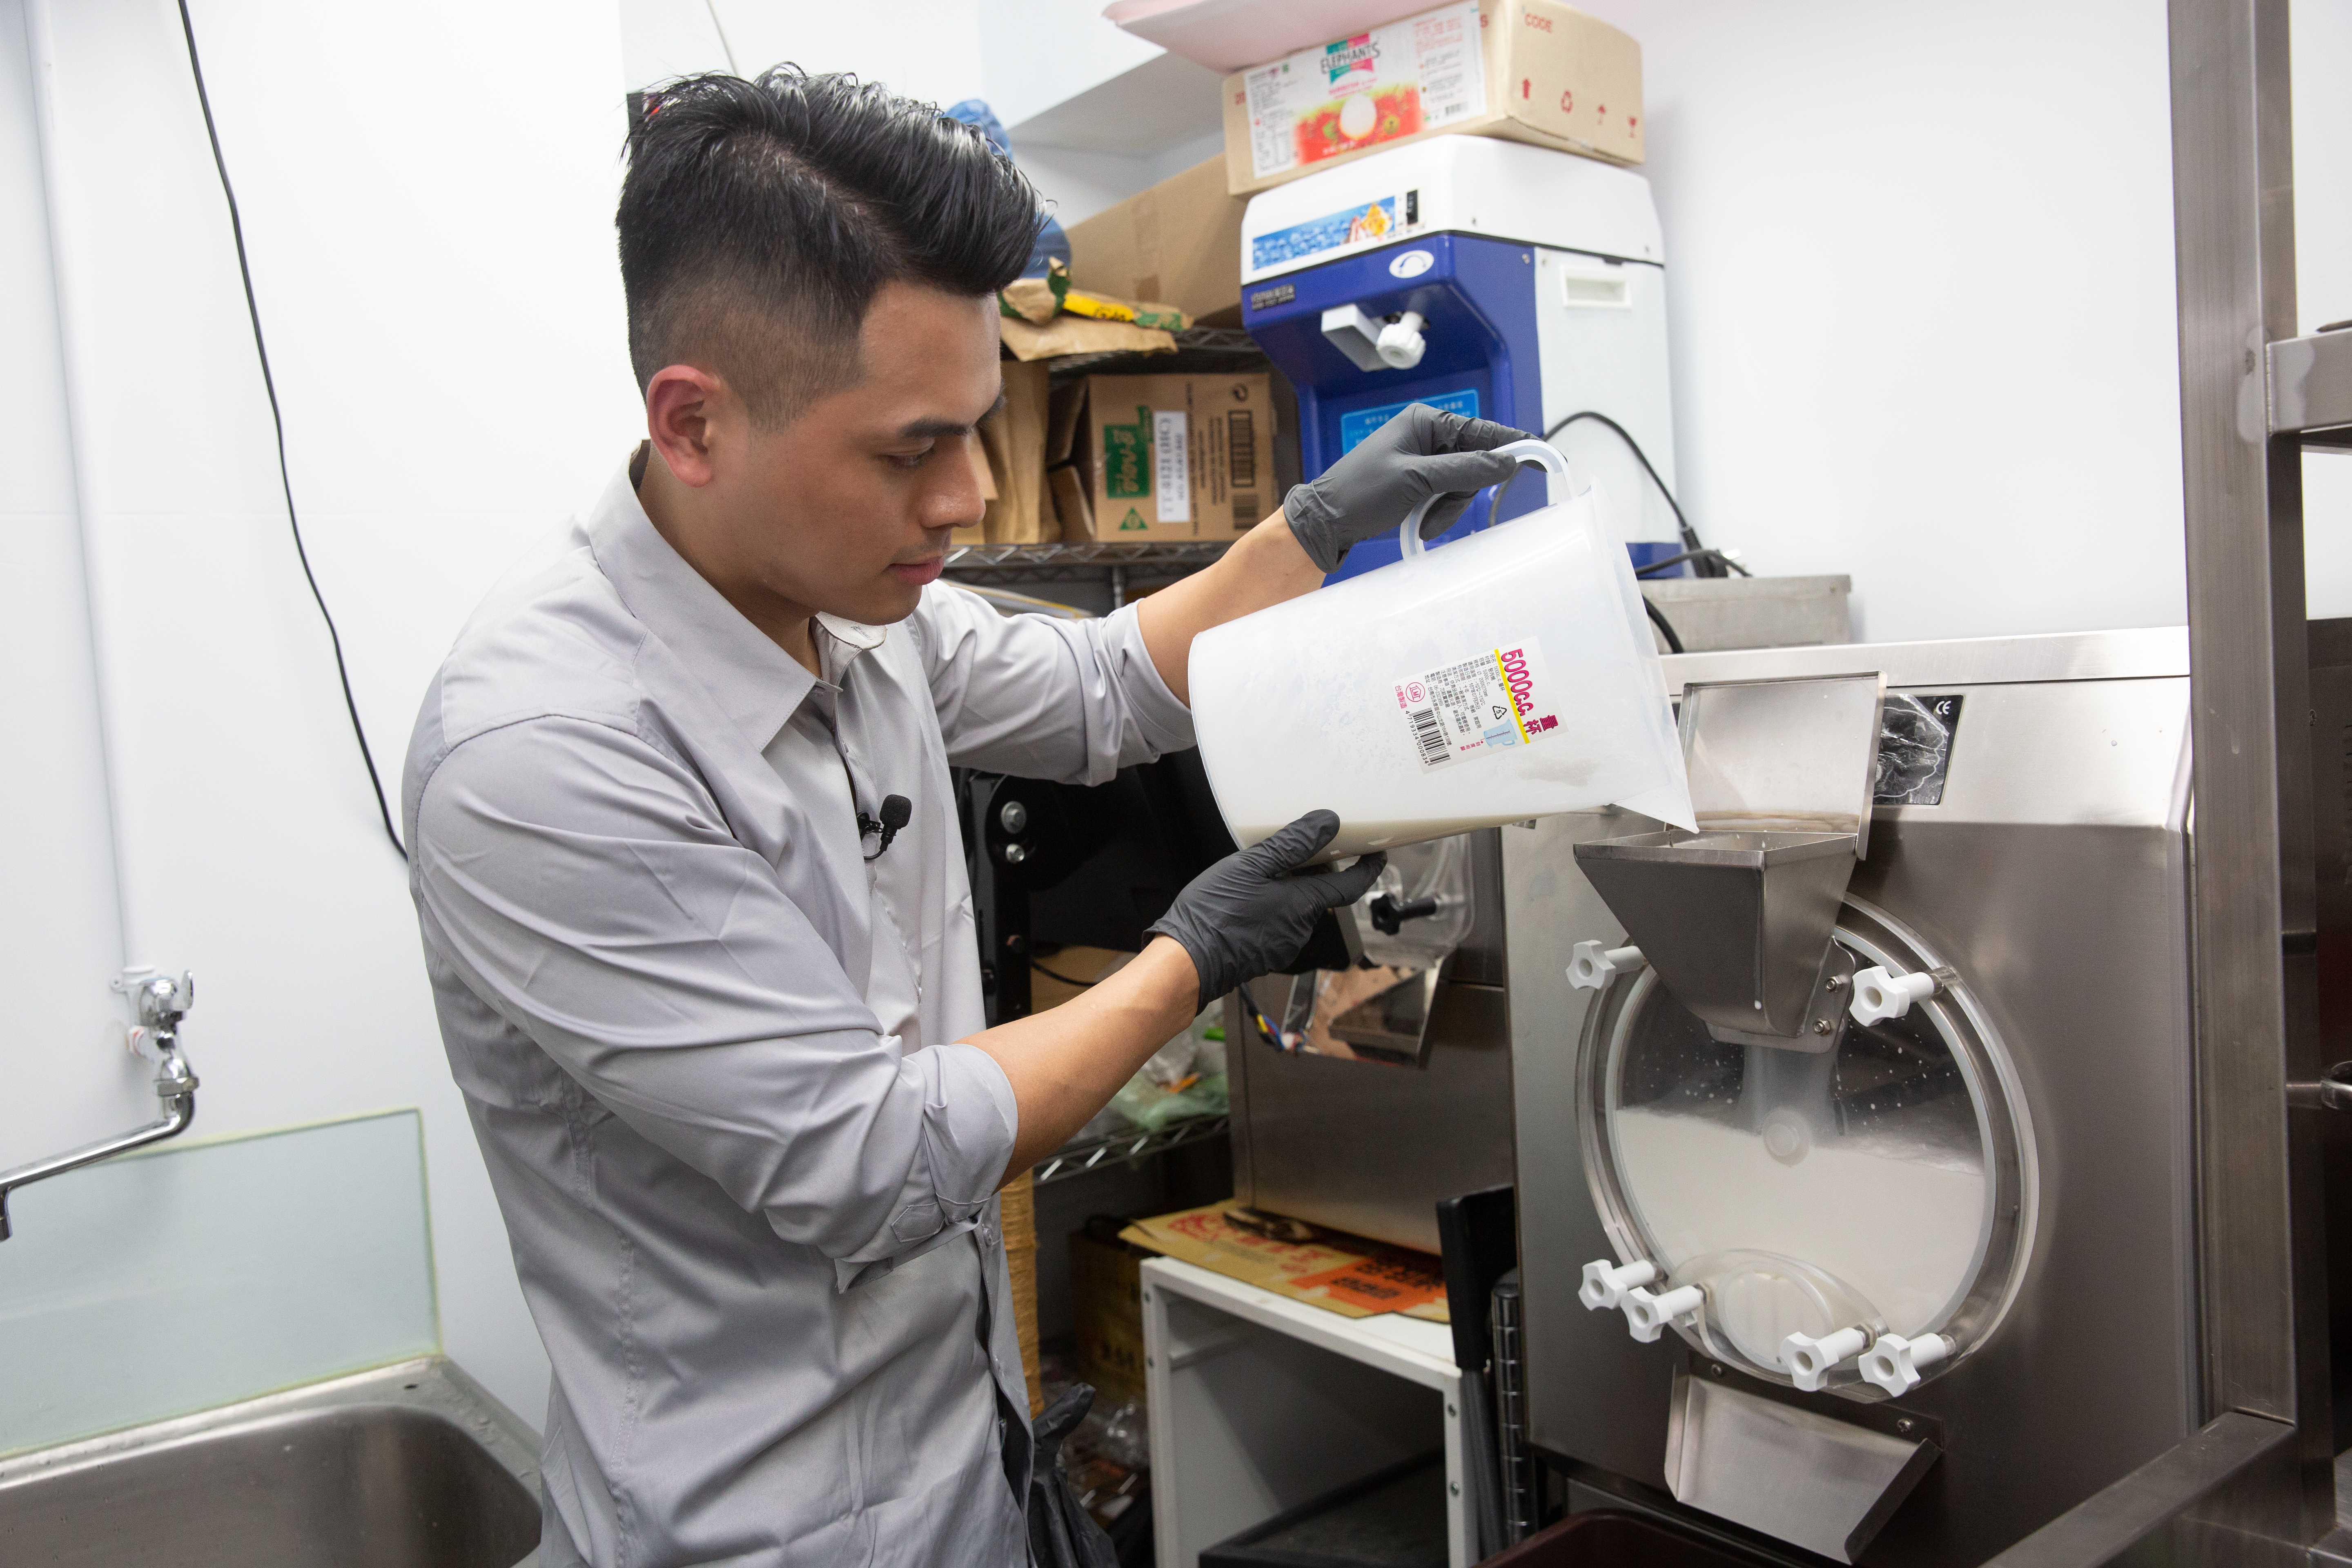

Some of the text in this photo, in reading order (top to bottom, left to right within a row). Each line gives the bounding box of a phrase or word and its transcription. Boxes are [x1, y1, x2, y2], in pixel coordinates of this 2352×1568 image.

[1320, 40, 1381, 74] ELEPHANTS
[1501, 648, 1533, 716] 5000c.c.
[1394, 685, 1408, 709] 台灣製造
[1523, 715, 1558, 735] 量杯
